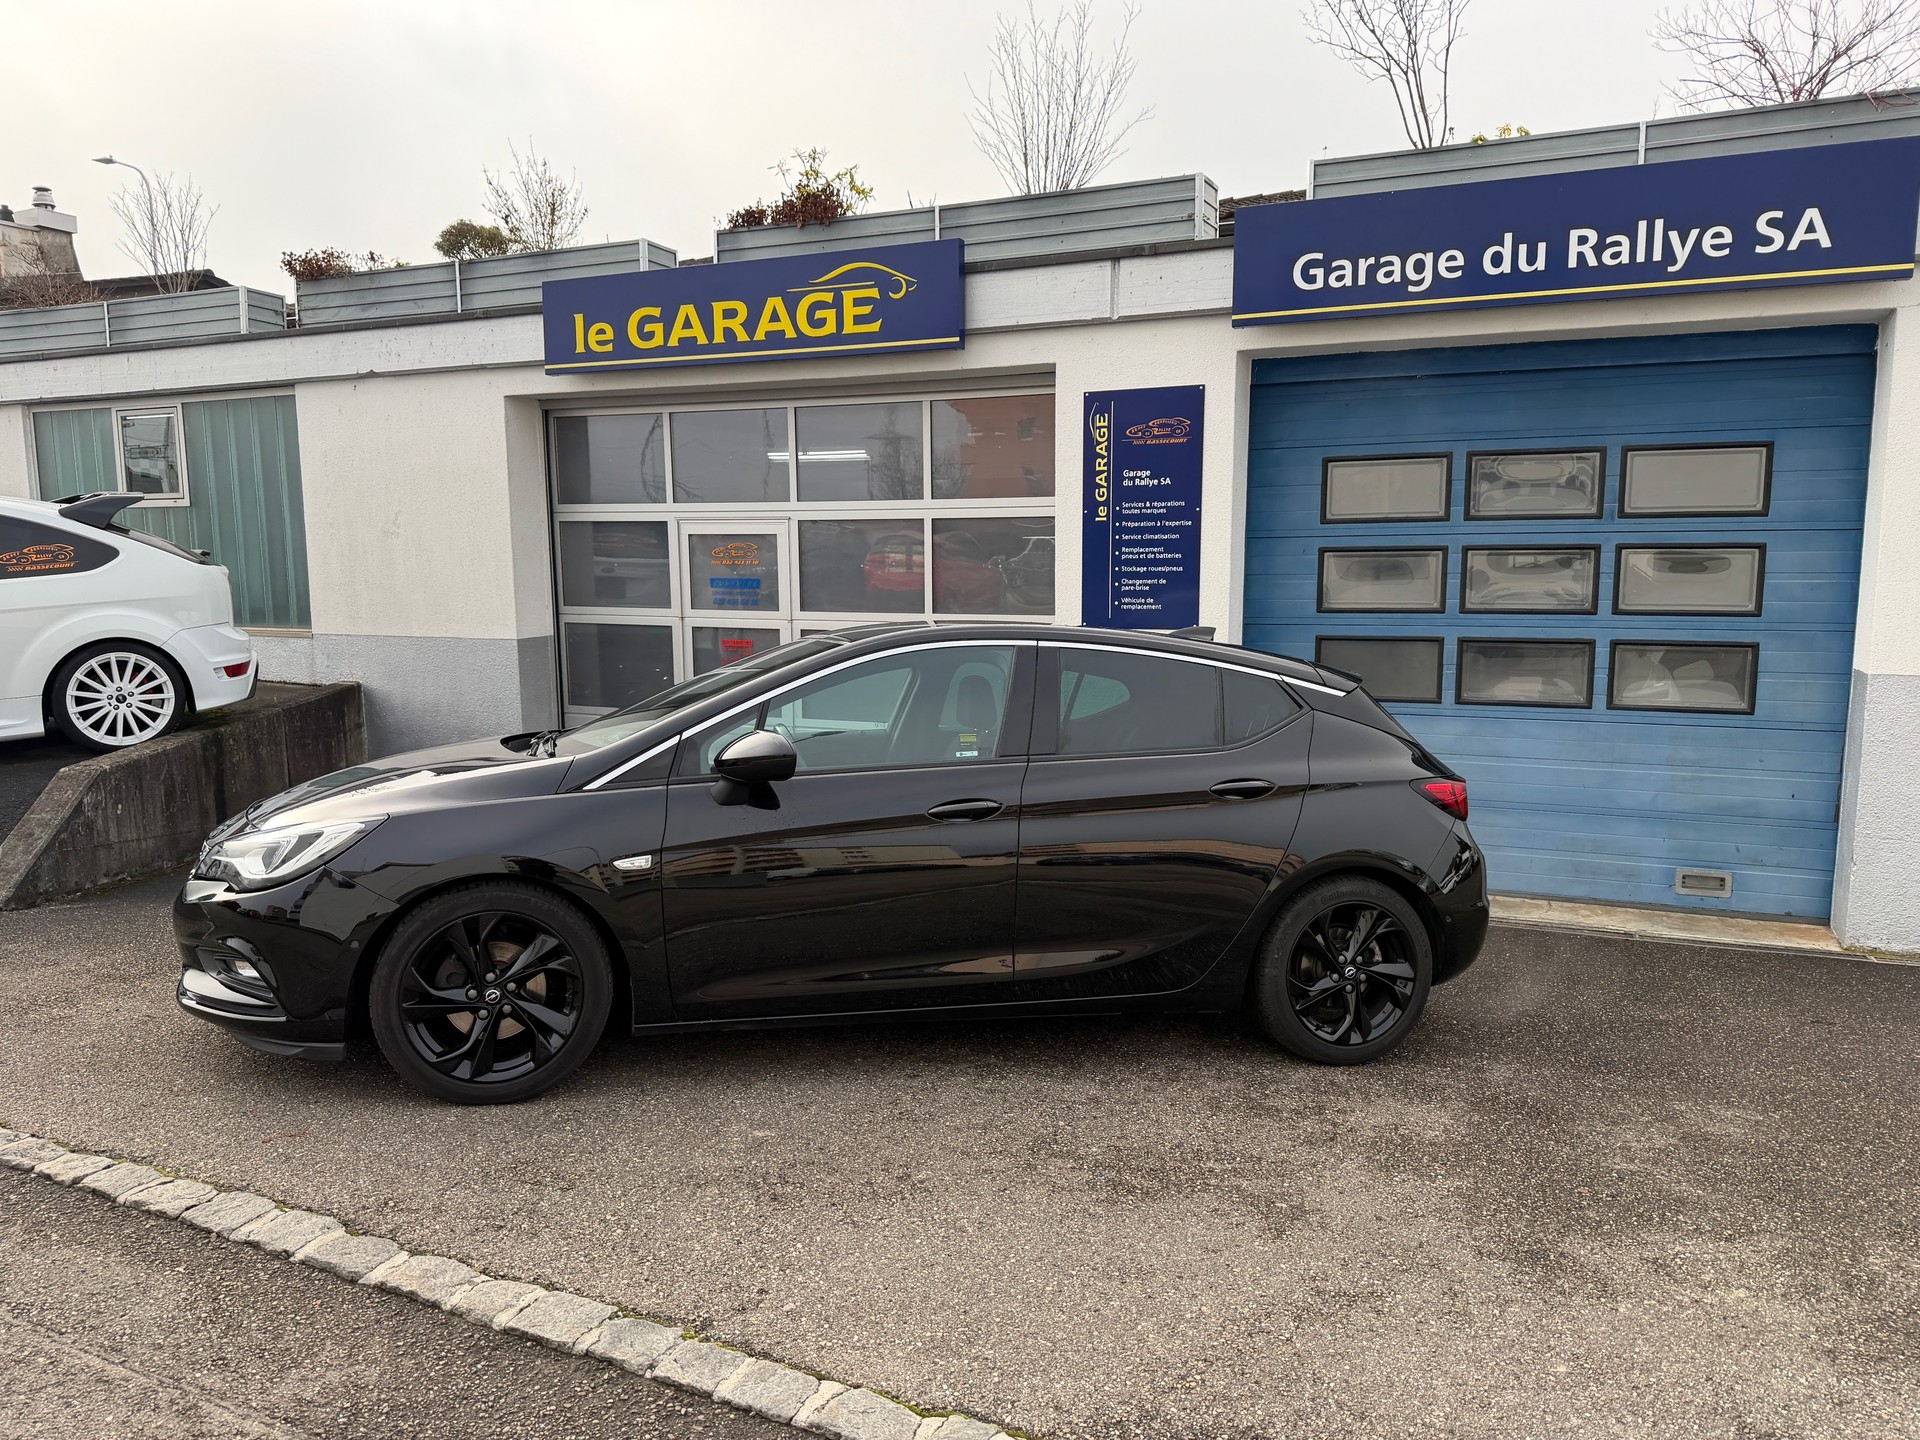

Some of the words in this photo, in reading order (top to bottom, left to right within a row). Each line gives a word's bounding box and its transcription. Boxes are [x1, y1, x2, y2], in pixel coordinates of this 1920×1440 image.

[1292, 249, 1466, 294] Garage
[1482, 232, 1547, 276] du
[1567, 218, 1734, 272] Rallye
[1754, 207, 1832, 255] SA
[573, 312, 616, 354] le
[626, 287, 884, 351] GARAGE
[1095, 412, 1109, 502] GARAGE
[1123, 469, 1151, 478] Garage
[1122, 478, 1133, 487] du
[1134, 477, 1159, 487] Rallye
[1160, 477, 1171, 485] SA
[1151, 500, 1185, 508] réparations
[1095, 505, 1108, 522] le
[1121, 520, 1156, 528] Préparation
[1161, 519, 1192, 527] l'expertise
[1142, 532, 1180, 540] climatisation
[1121, 546, 1164, 554] Remplacement
[1121, 565, 1147, 573] Stockage
[1148, 565, 1184, 573] roues/pneus
[1121, 578, 1158, 586] Changement
